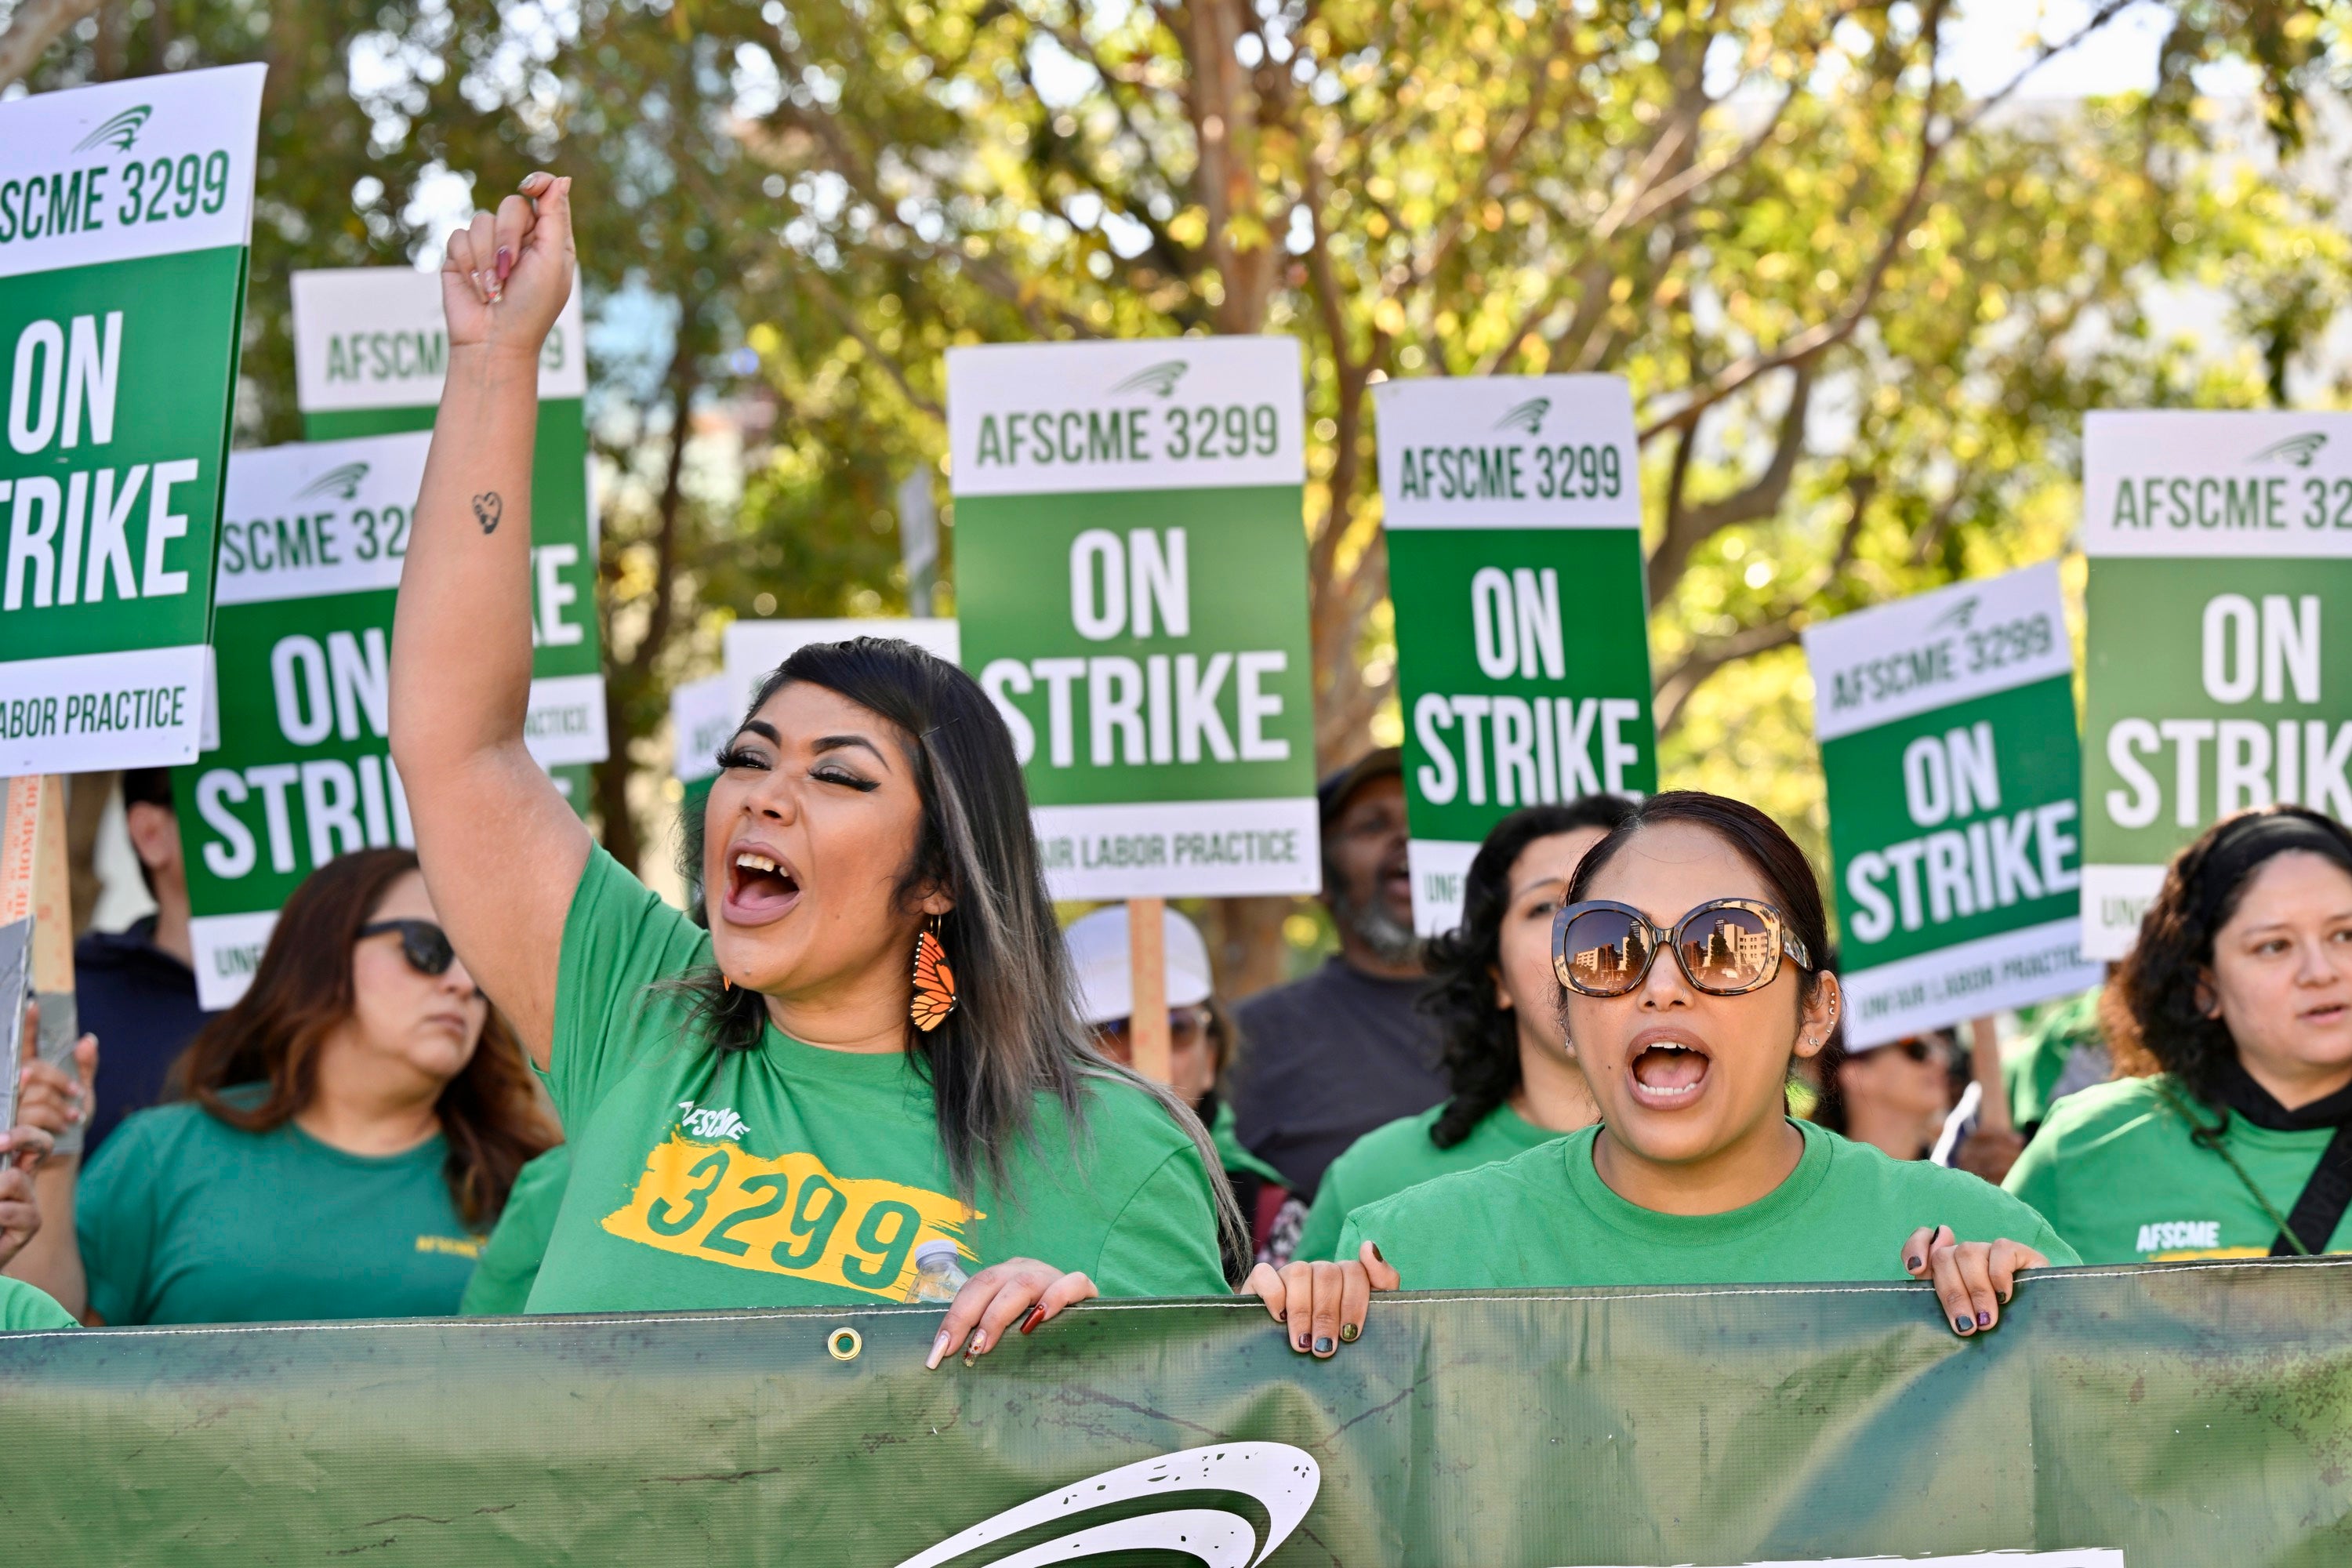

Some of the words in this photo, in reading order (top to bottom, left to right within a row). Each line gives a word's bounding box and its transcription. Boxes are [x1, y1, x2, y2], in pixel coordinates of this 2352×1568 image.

[119, 150, 230, 226] 3299
[8, 310, 123, 455] ON
[976, 407, 1151, 467] AFSCME
[1165, 404, 1279, 459] 3299
[1400, 446, 1526, 501] AFSCME
[1535, 444, 1622, 499] 3299
[2113, 477, 2288, 531] AFSCME
[353, 506, 418, 561] 32
[1069, 527, 1190, 641] ON
[1471, 566, 1566, 681] ON
[1832, 637, 1957, 711] AFSCME
[1965, 612, 2053, 674] 3299
[2201, 593, 2321, 704] ON
[64, 685, 187, 734] PRACTICE
[270, 627, 390, 746] ON
[979, 651, 1290, 768] STRIKE
[1414, 692, 1644, 807] STRIKE
[1902, 719, 2002, 828] ON
[2106, 717, 2352, 829] STRIK
[1081, 833, 1167, 870] LABOR
[1173, 827, 1301, 865] PRACTICE
[1846, 797, 2082, 943] STRIKE
[647, 1149, 922, 1289] 3299
[2136, 1221, 2221, 1253] AFSCME
